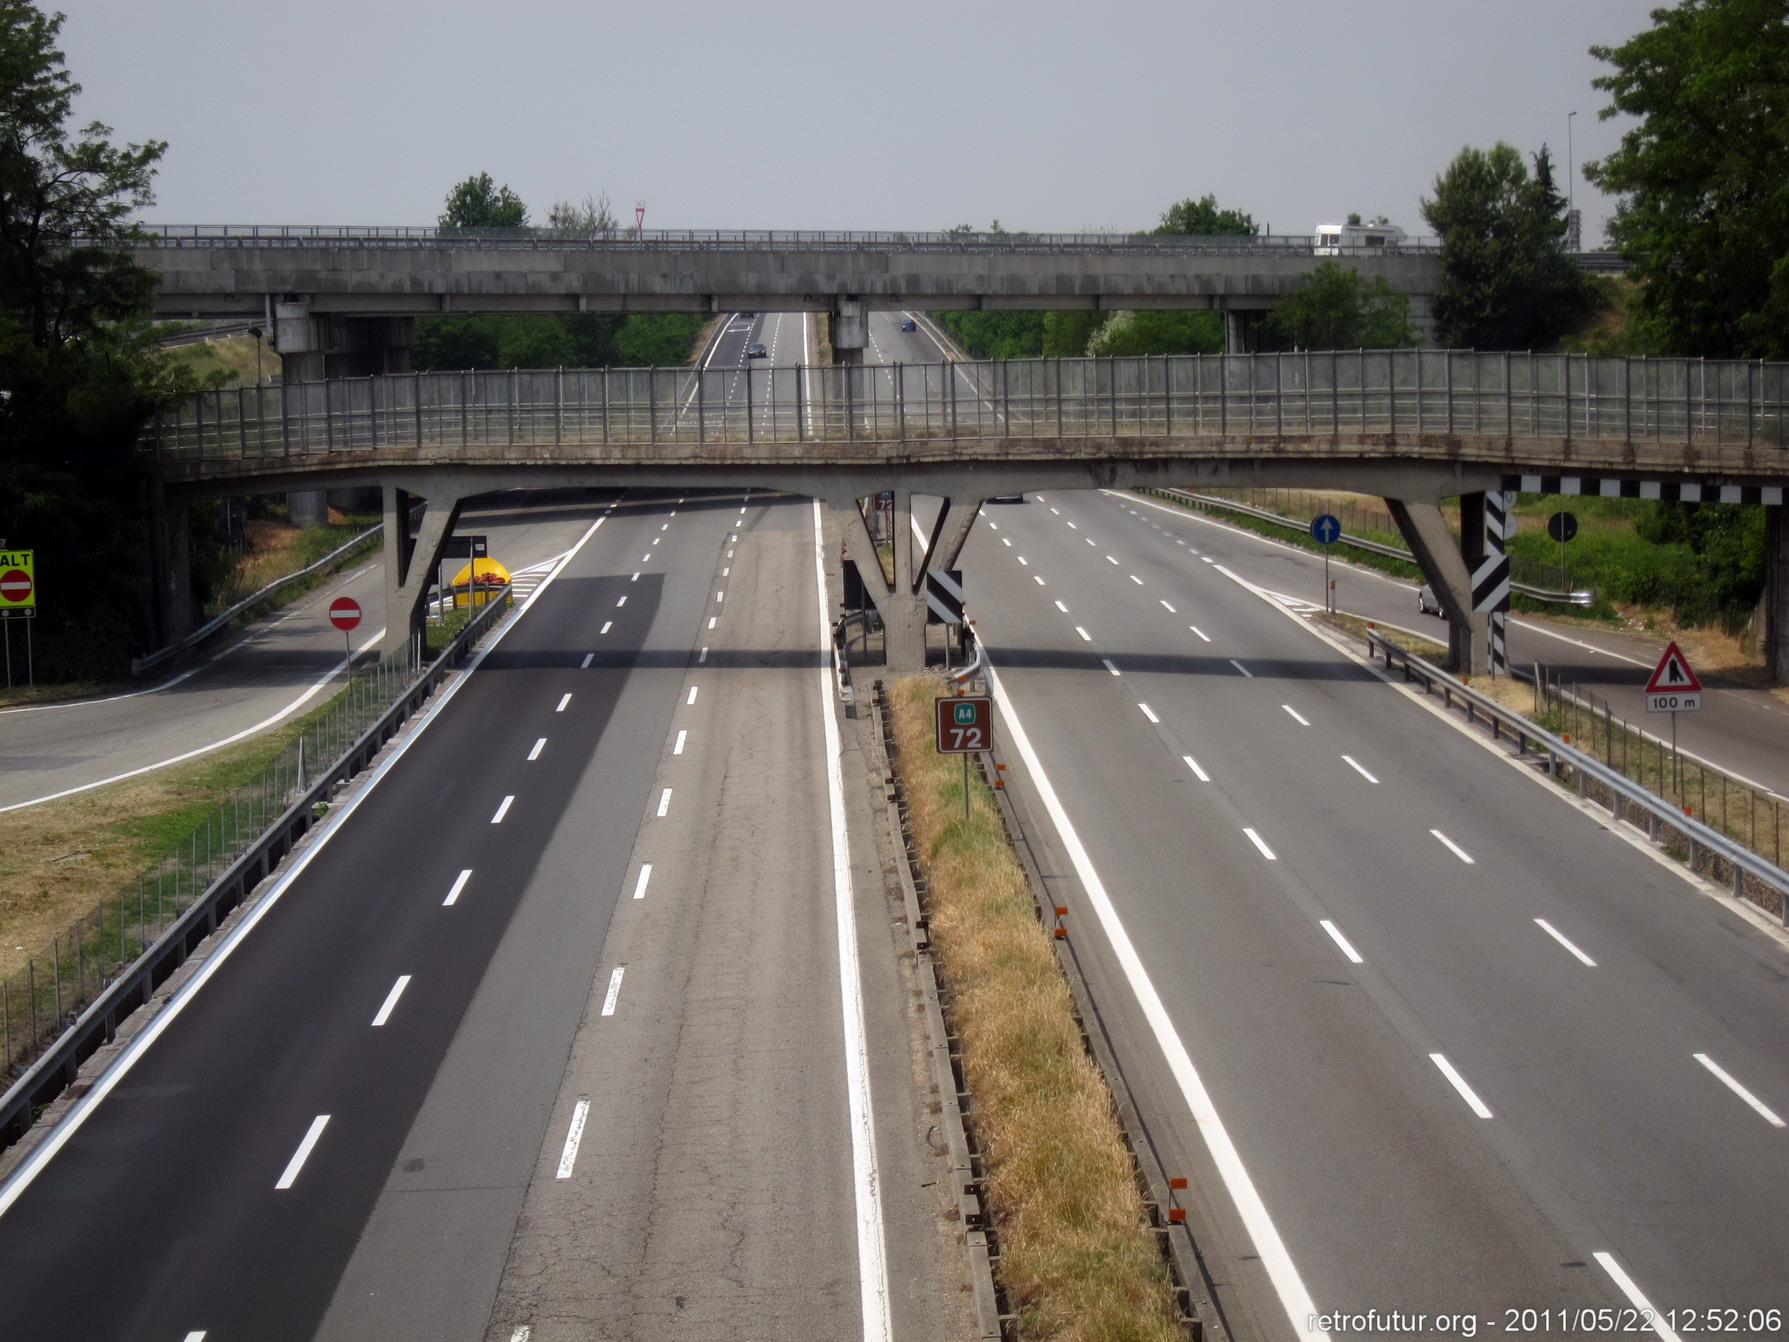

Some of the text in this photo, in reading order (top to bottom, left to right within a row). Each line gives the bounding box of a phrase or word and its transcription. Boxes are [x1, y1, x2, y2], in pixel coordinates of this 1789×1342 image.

[0, 554, 30, 566] ALT
[1653, 697, 1695, 708] 100 m
[958, 708, 972, 719] A4
[949, 727, 982, 749] 72
